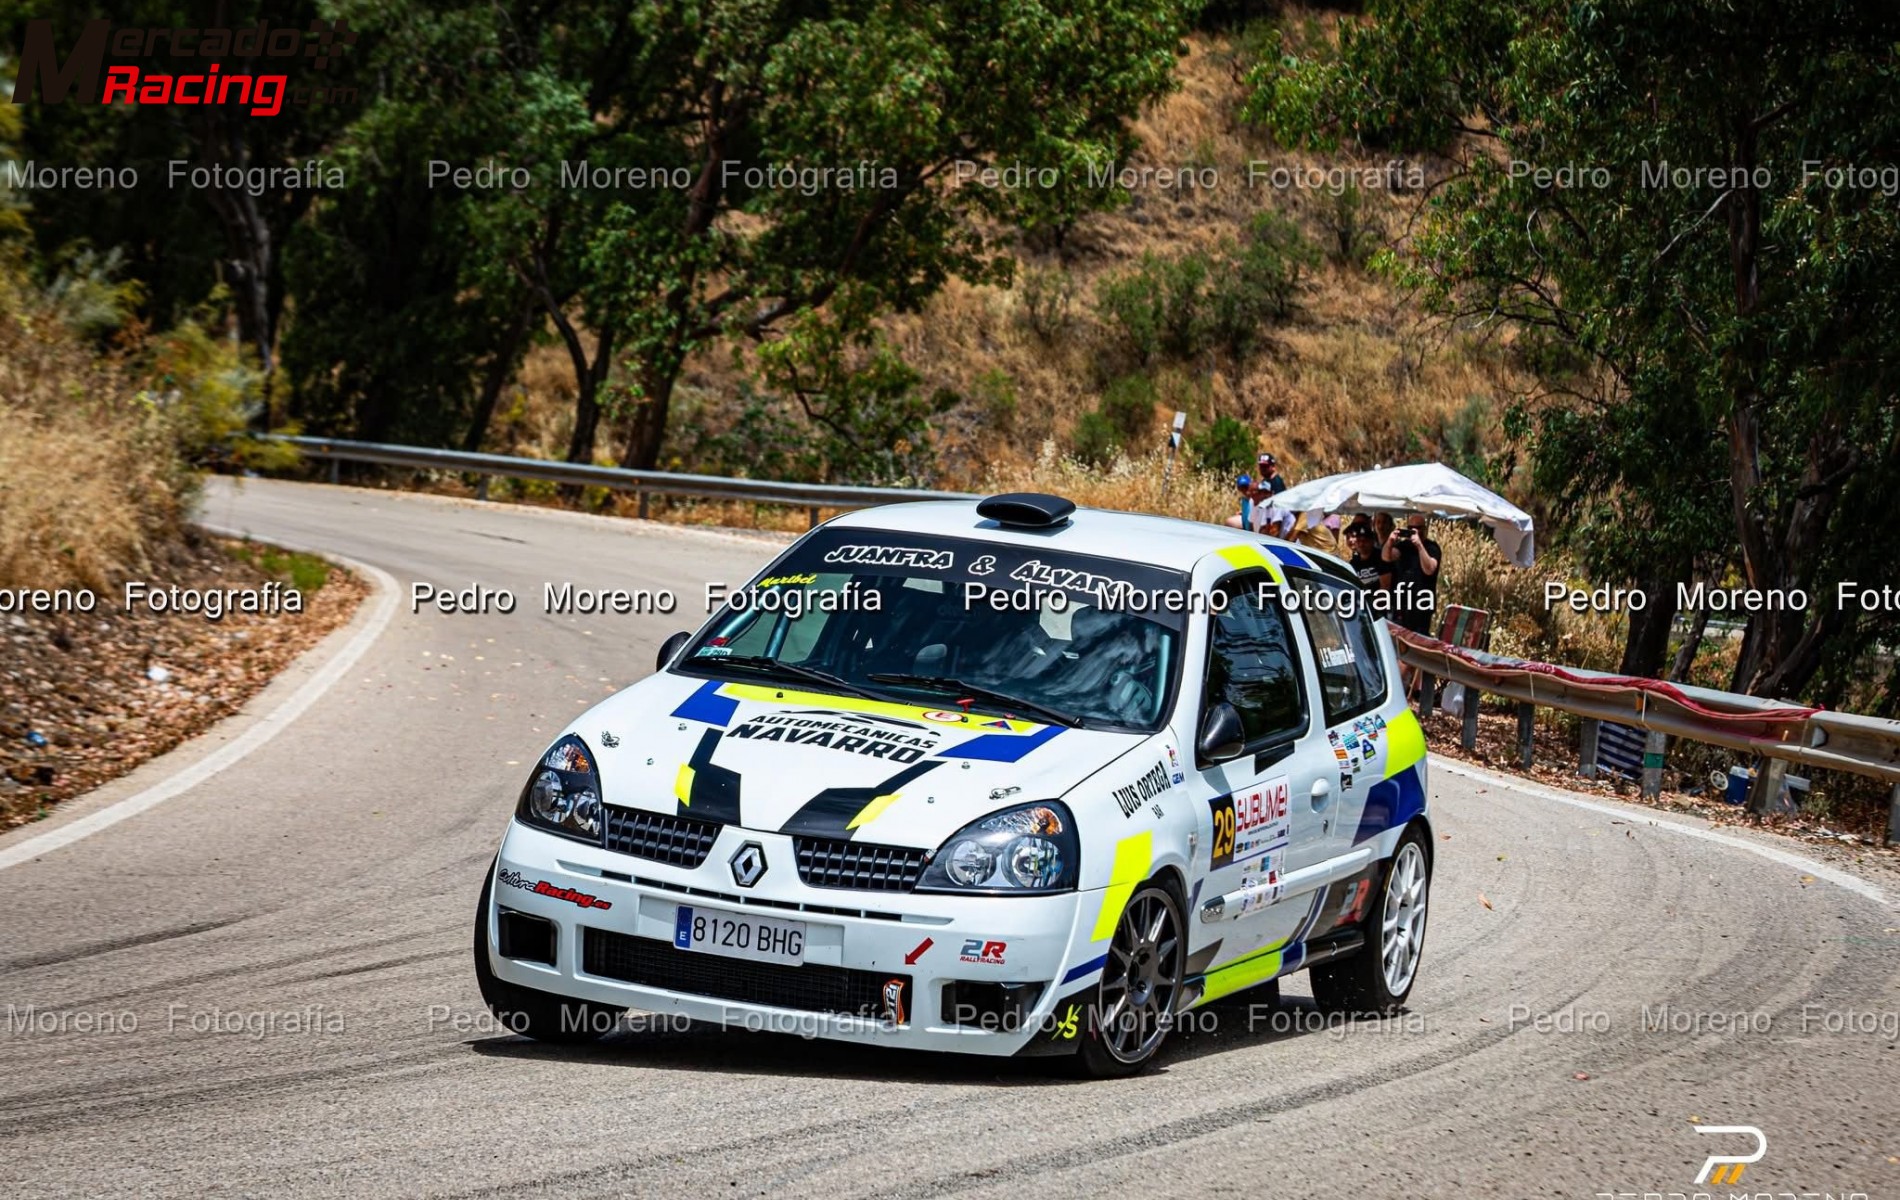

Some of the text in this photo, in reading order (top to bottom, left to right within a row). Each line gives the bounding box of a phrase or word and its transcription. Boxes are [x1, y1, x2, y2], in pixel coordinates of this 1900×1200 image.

[824, 545, 954, 569] JUANFRA
[968, 555, 996, 576] &
[726, 724, 926, 765] NAVARRO
[750, 714, 938, 749] AUTOMECANICAS
[1112, 760, 1172, 819] LUIS ORTEGA
[1213, 806, 1235, 858] 29
[679, 916, 803, 956] E 8120 BHG
